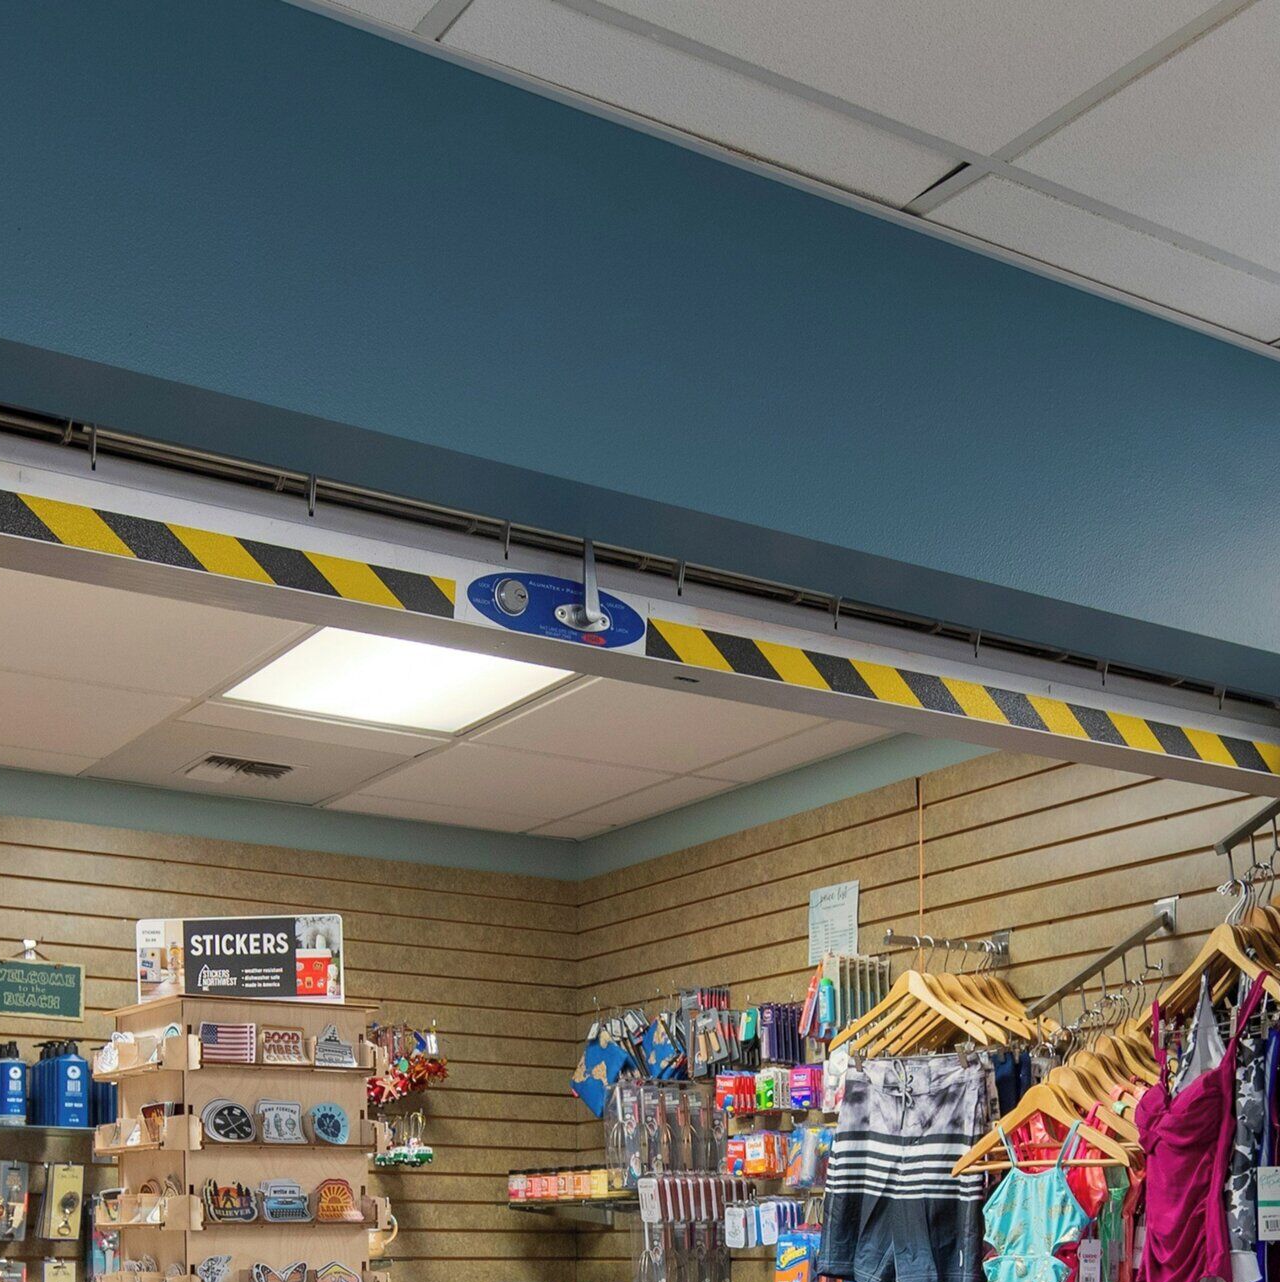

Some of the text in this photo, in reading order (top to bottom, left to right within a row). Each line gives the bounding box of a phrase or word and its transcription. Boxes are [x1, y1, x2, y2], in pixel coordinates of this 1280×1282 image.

[190, 932, 289, 957] STICKERS
[202, 969, 230, 978] STICKERS
[202, 977, 238, 986] NORTHWEST
[31, 984, 46, 993] the
[3, 991, 60, 1009] BEACH
